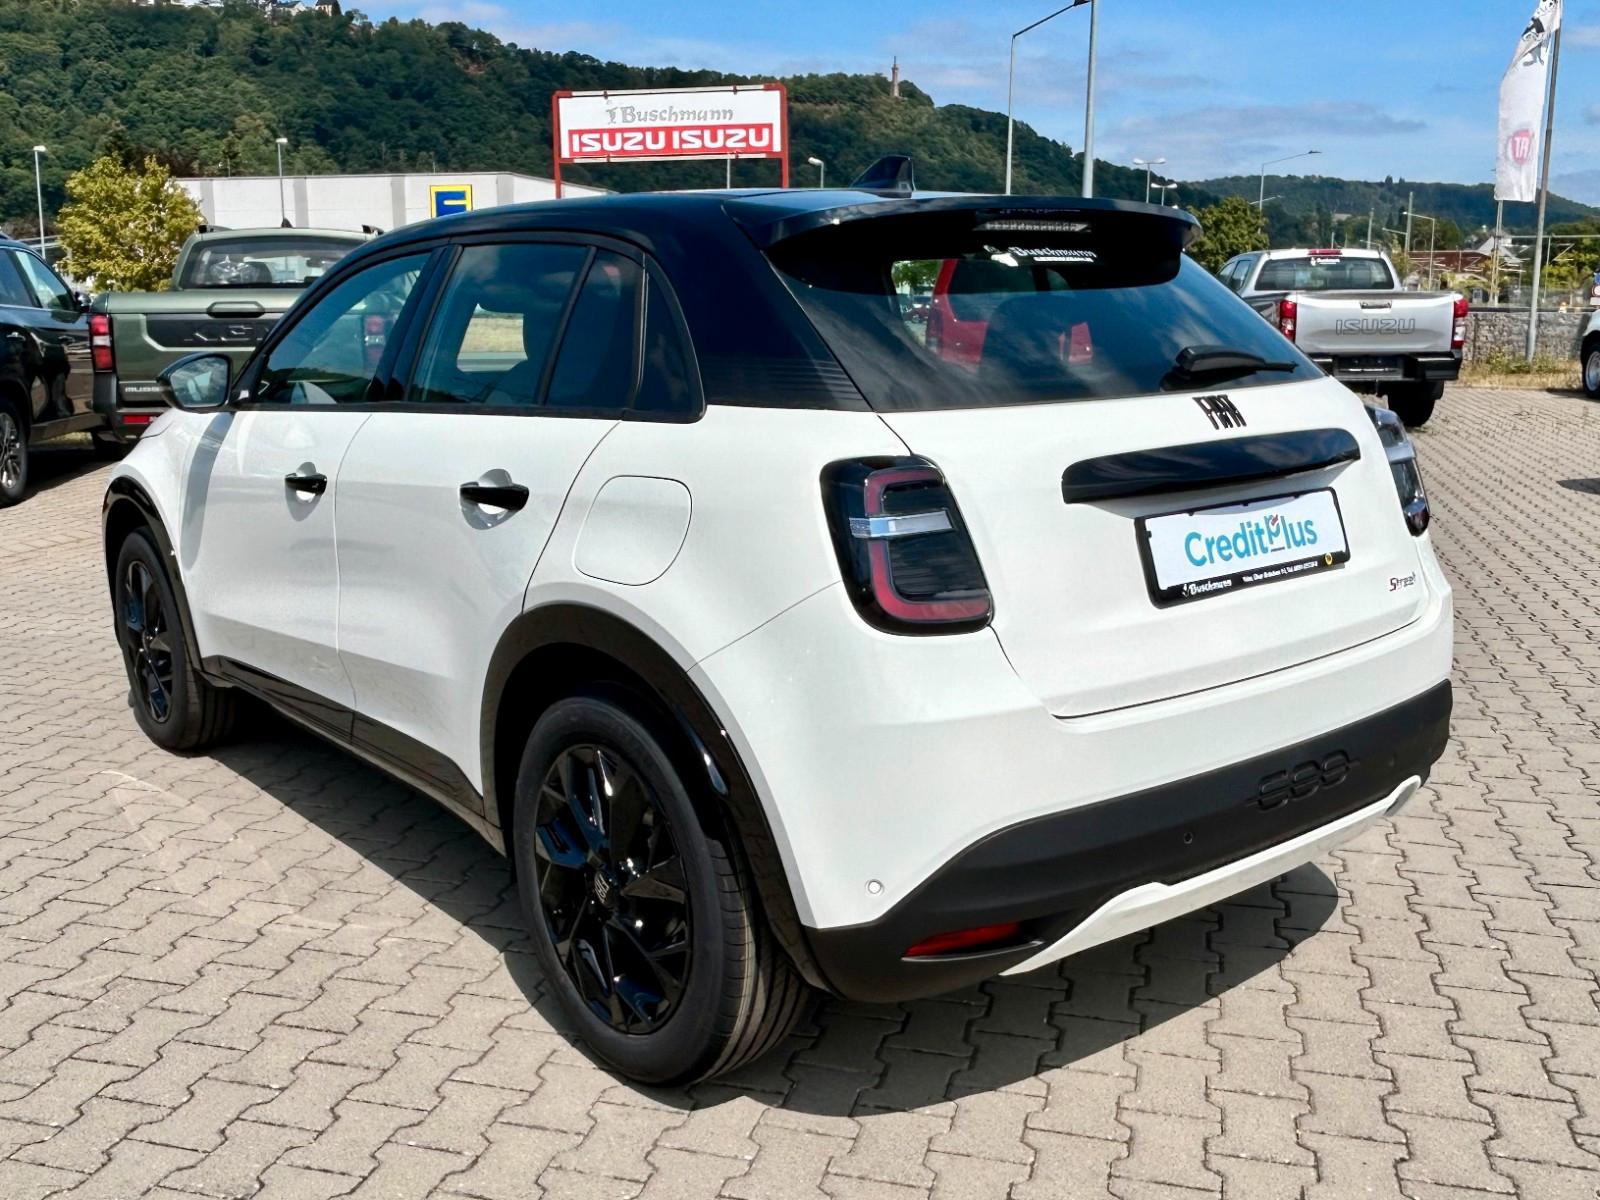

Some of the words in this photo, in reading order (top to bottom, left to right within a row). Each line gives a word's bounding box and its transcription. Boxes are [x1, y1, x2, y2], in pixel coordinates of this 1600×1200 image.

[621, 105, 734, 123] Buschmann
[571, 131, 666, 153] ISUZU
[672, 127, 770, 150] ISUZU
[1335, 318, 1416, 336] ISUZU
[1184, 514, 1318, 567] CreditPlus
